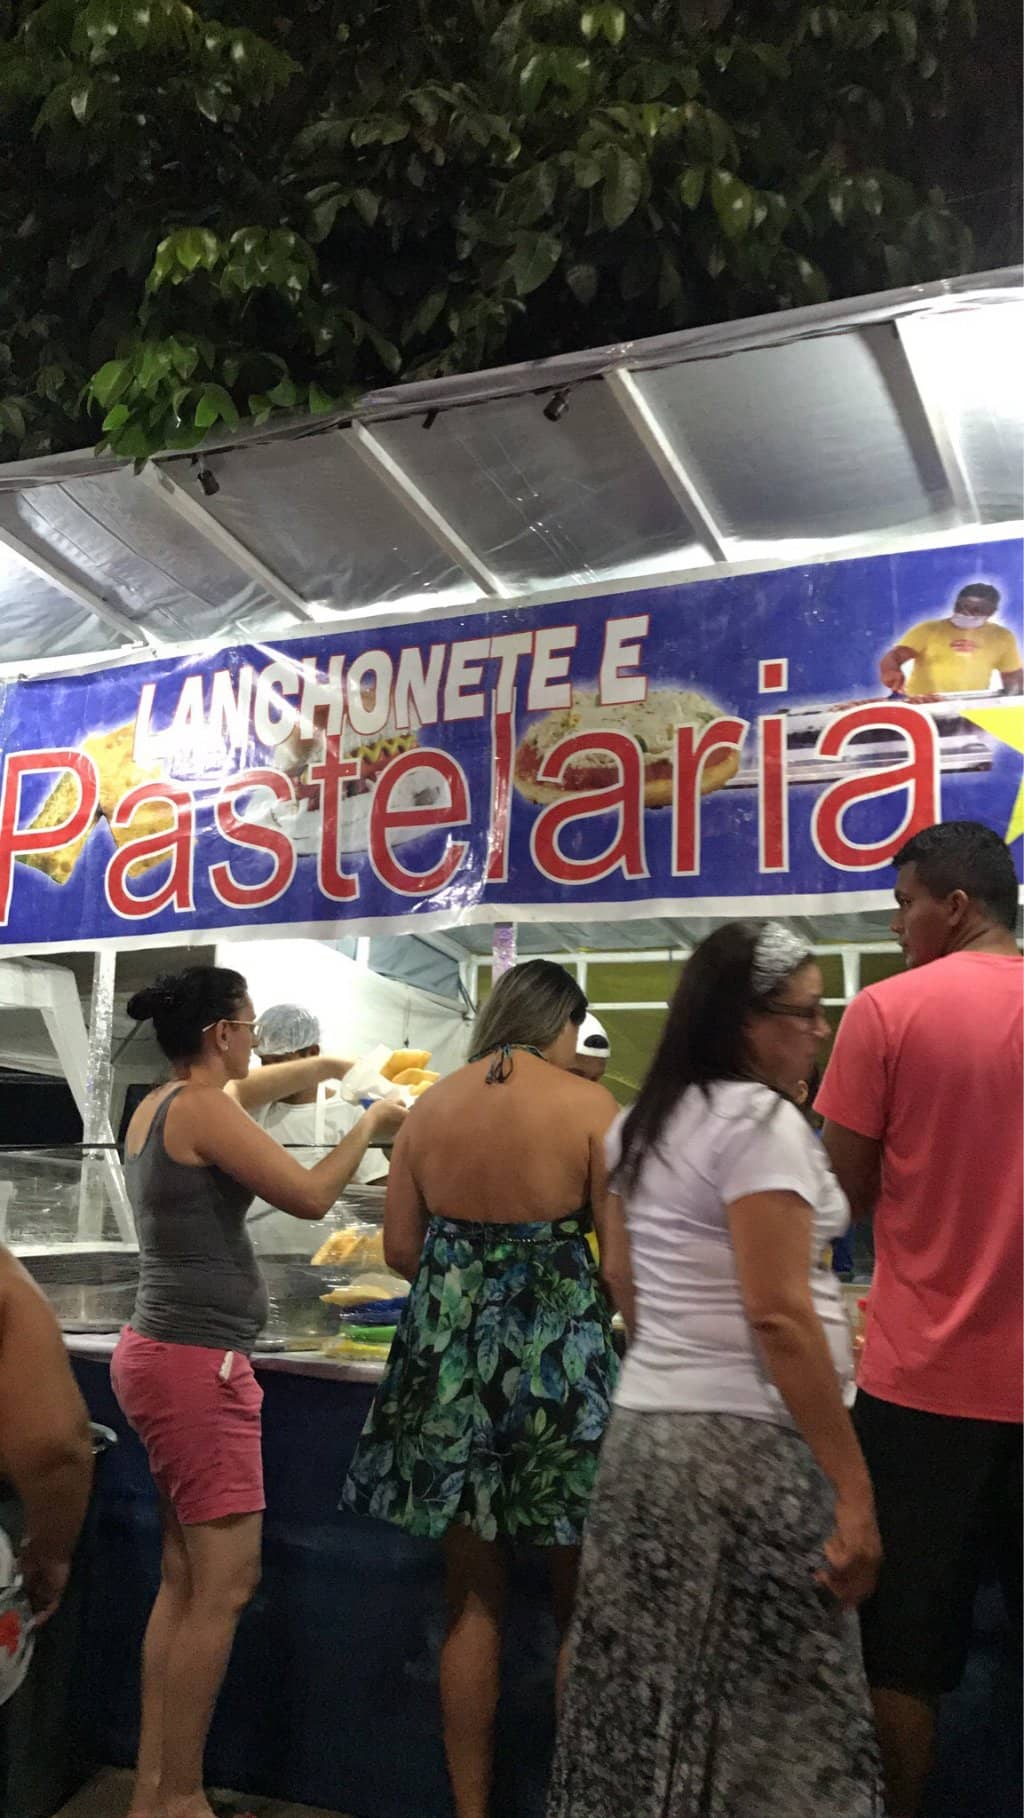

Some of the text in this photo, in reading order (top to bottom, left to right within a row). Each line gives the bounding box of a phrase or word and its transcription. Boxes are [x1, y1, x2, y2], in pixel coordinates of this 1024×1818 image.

[0, 658, 942, 926] Pastelaria
[132, 614, 650, 763] LANCHONETE E
